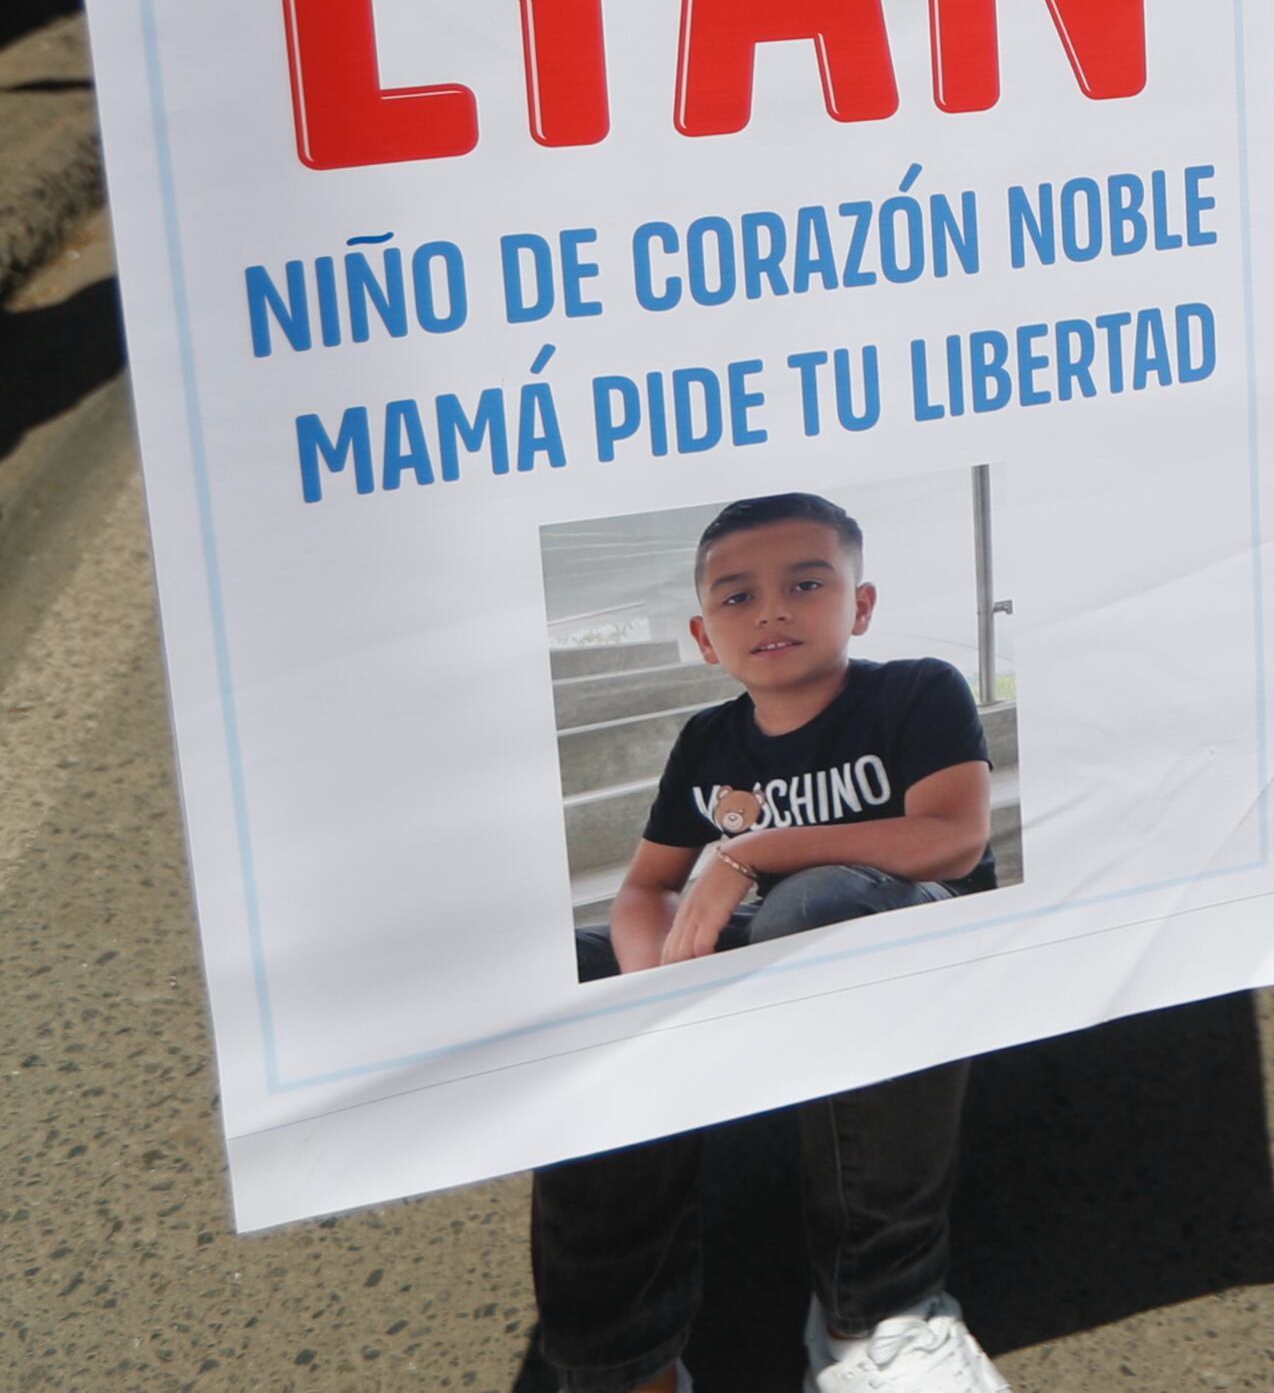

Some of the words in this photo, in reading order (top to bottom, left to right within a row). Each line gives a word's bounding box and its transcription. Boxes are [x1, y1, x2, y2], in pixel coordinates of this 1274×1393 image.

[245, 231, 468, 357] NIÑO
[501, 228, 603, 323] DE
[633, 163, 980, 311] CORAZÓN
[1008, 165, 1217, 268] NOBLE
[295, 344, 567, 503] MAMÁ
[592, 359, 768, 462] PIDE
[788, 345, 880, 436] TU
[912, 303, 1216, 422] LIBERTAD
[693, 754, 891, 832] SCHINO
